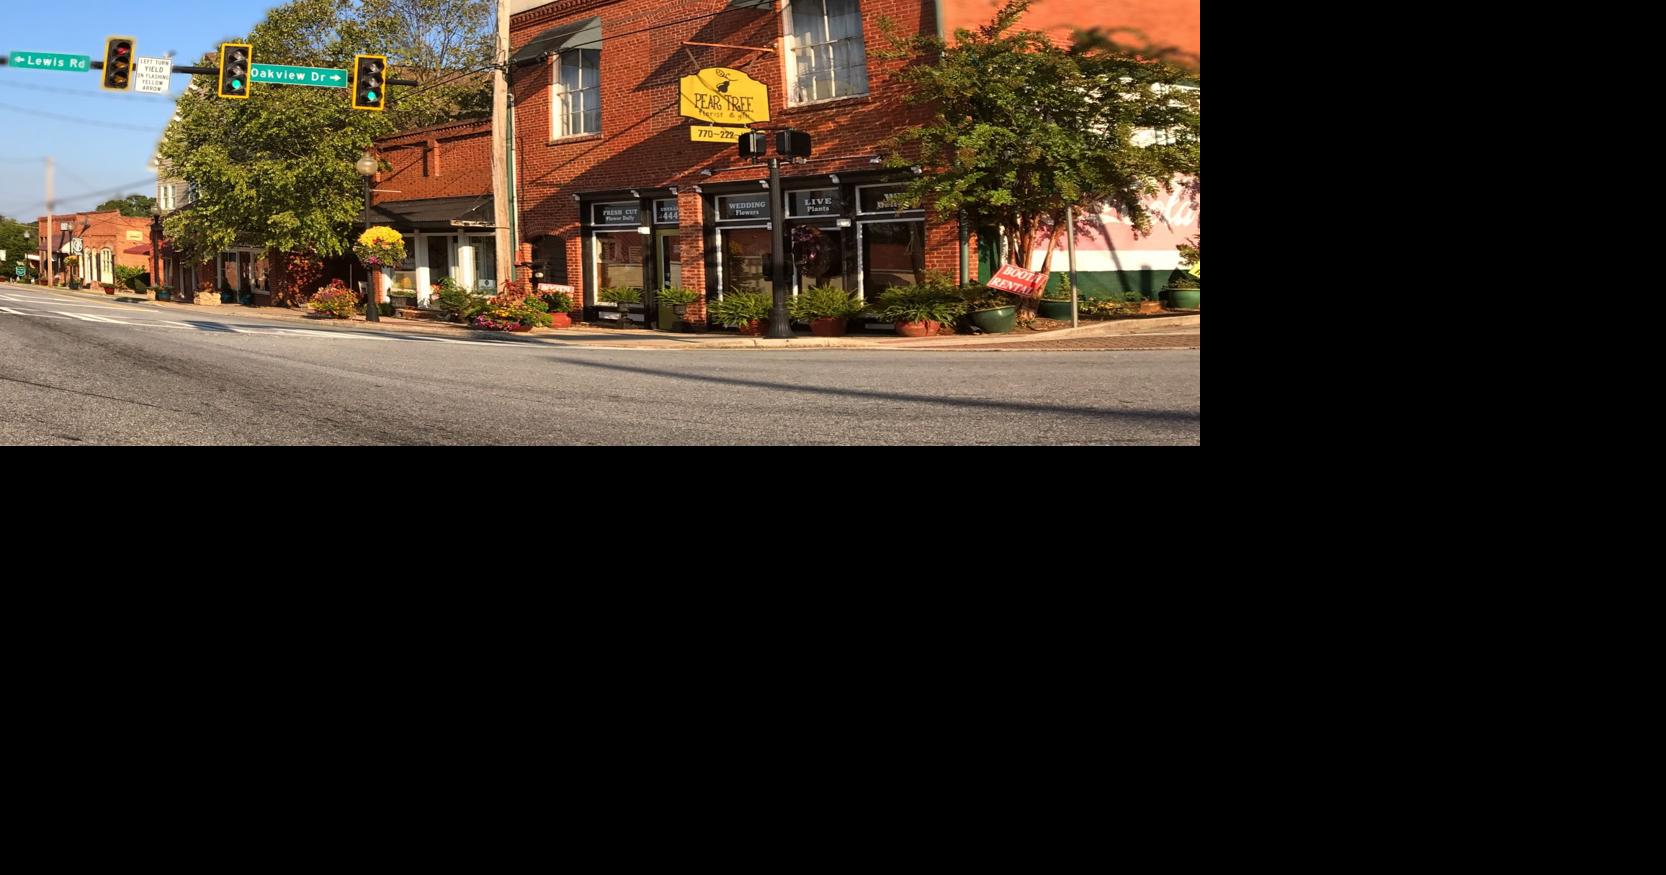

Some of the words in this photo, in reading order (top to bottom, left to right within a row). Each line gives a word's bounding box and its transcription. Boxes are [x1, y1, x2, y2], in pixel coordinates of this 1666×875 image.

[27, 55, 64, 67] Lewis
[69, 58, 85, 69] Rd
[251, 68, 305, 80] Oakview
[311, 71, 326, 82] Dr
[694, 93, 722, 110] PEAR
[725, 94, 754, 112] TREE
[698, 129, 740, 139] 770-222-
[728, 201, 766, 210] WEDDING
[804, 197, 832, 206] LIVE
[735, 208, 760, 216] Flowers
